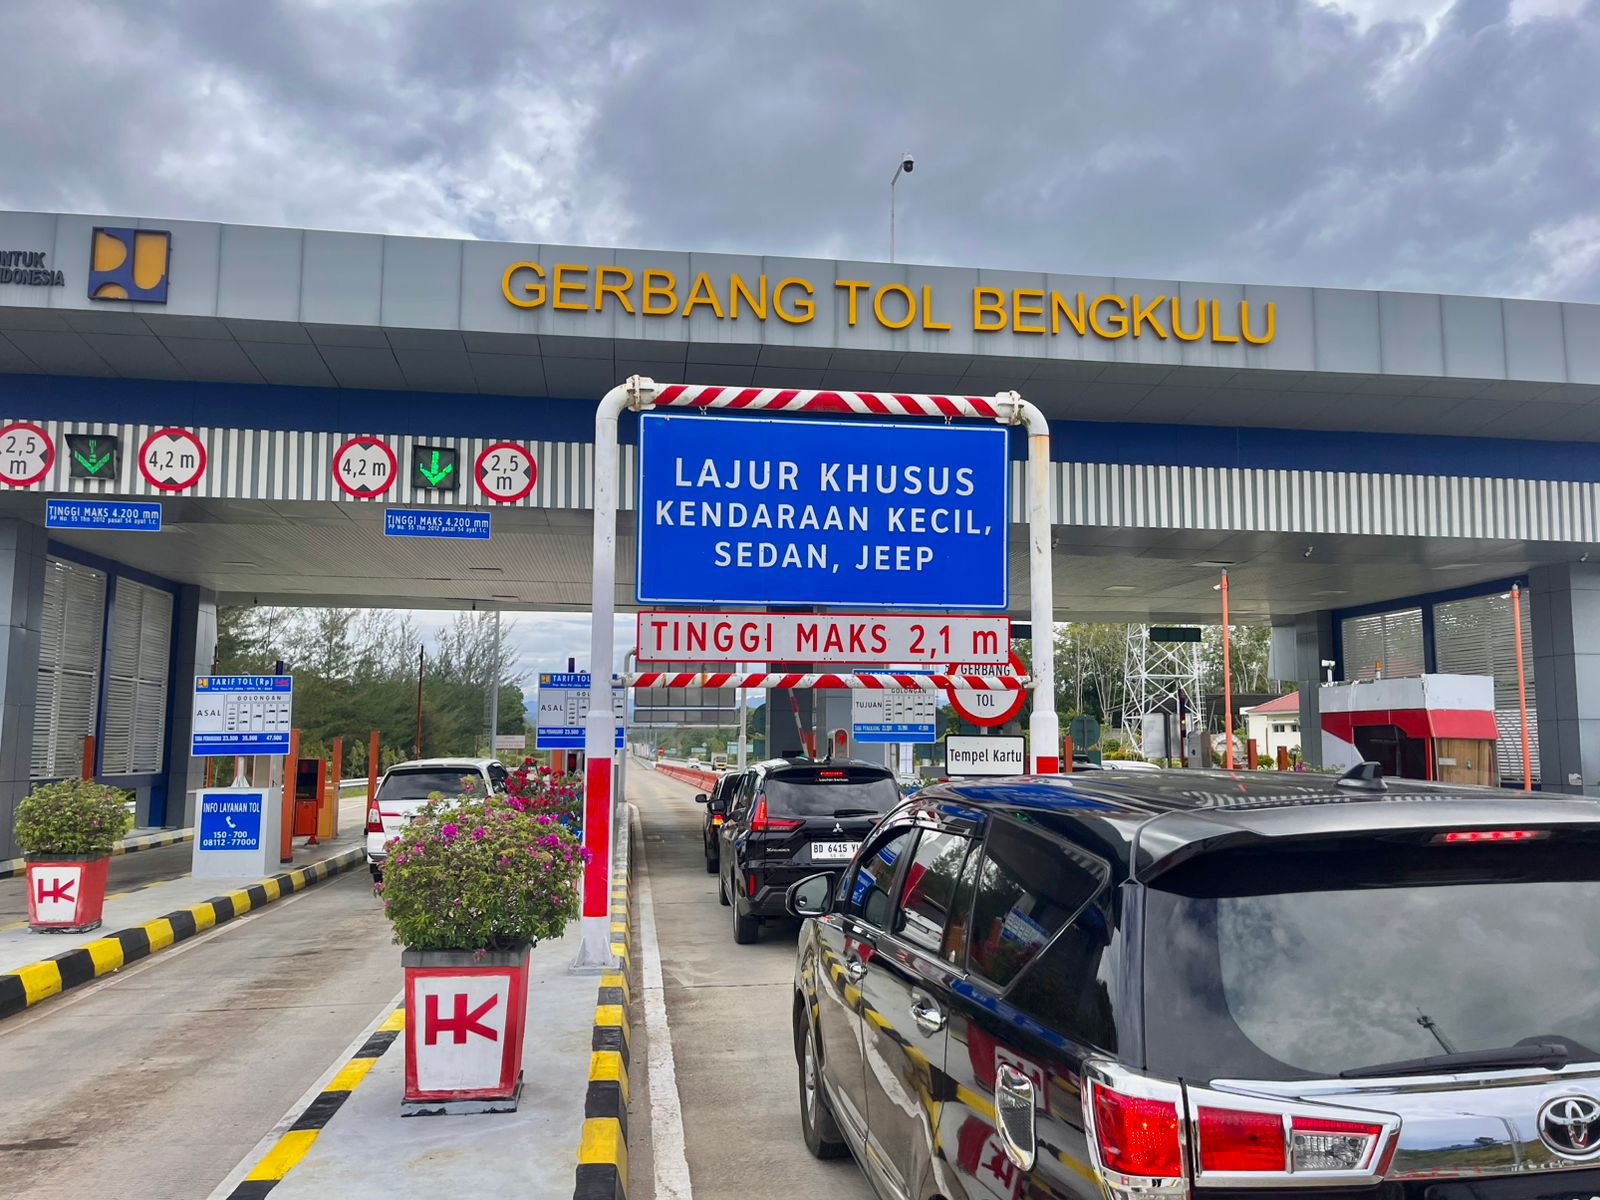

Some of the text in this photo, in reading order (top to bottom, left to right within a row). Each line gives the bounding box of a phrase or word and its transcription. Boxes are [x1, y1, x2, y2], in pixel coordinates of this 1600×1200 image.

[501, 260, 1275, 344] GERBANG TOL BENGKULU
[6, 436, 36, 455] 2,5
[10, 460, 26, 474] m
[149, 451, 194, 470] 4,2 m
[342, 459, 386, 478] 4,2 m
[491, 454, 519, 474] 2,5
[497, 476, 511, 490] m
[675, 458, 975, 497] LAJUR KHUSUS
[49, 506, 159, 519] TINGGI MAKS 4.200 mm
[387, 515, 416, 525] TINGGI
[420, 516, 442, 526] MAKS
[446, 518, 470, 527] 4.200
[656, 500, 992, 536] KENDARAAN KECIL,
[714, 542, 934, 574] SEDAN, JEEP
[651, 621, 998, 659] TINGGI MAKS 2,1 m
[255, 678, 274, 686] (Rp)
[976, 694, 995, 706] TOL
[950, 749, 1022, 765] Tempel Kartu
[203, 802, 260, 813] INFO LAYANAN TOL
[814, 844, 823, 853] BD
[828, 844, 847, 852] 6415
[38, 878, 75, 904] HK
[424, 993, 498, 1046] HK
